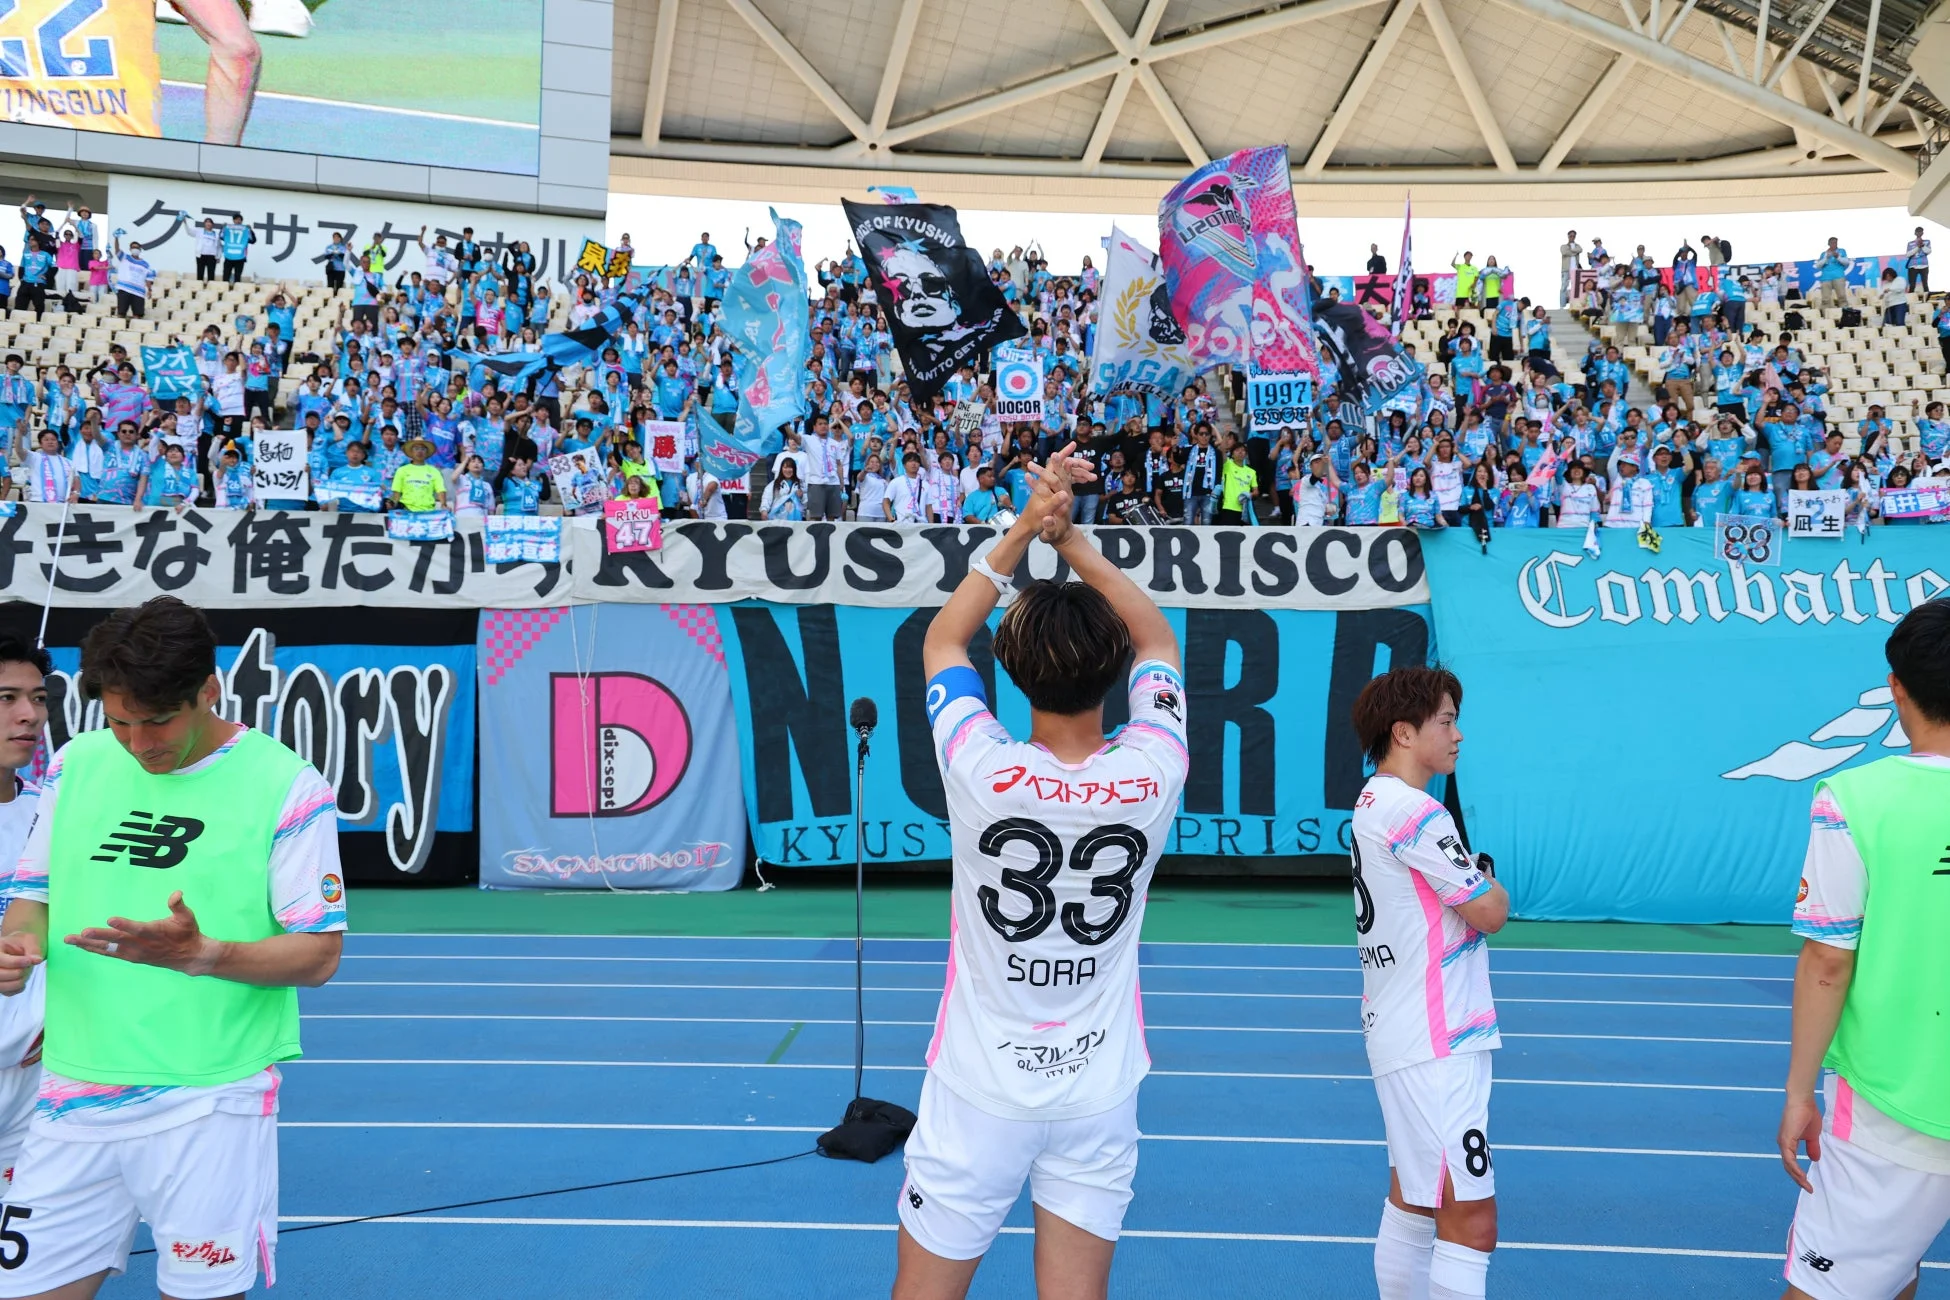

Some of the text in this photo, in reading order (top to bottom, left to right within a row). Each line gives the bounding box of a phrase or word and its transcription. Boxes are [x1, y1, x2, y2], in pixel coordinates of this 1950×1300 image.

[0, 88, 128, 115] UNGGUN
[873, 216, 892, 228] OF
[893, 215, 957, 249] KYUSHU
[939, 357, 954, 372] TO
[953, 339, 977, 361] GET
[997, 400, 1042, 415] UOCOR
[1254, 381, 1307, 408] 1997
[551, 456, 571, 475] 33
[616, 509, 651, 522] RIKU
[615, 521, 654, 547] 47
[1094, 527, 1425, 596] PRISCO
[602, 728, 619, 808] dix-sept
[1024, 774, 1159, 805] ベストアメニティ
[692, 843, 721, 870] 17
[976, 817, 1149, 946] 33
[1007, 953, 1096, 987] SORA
[172, 1240, 237, 1268] キングダム
